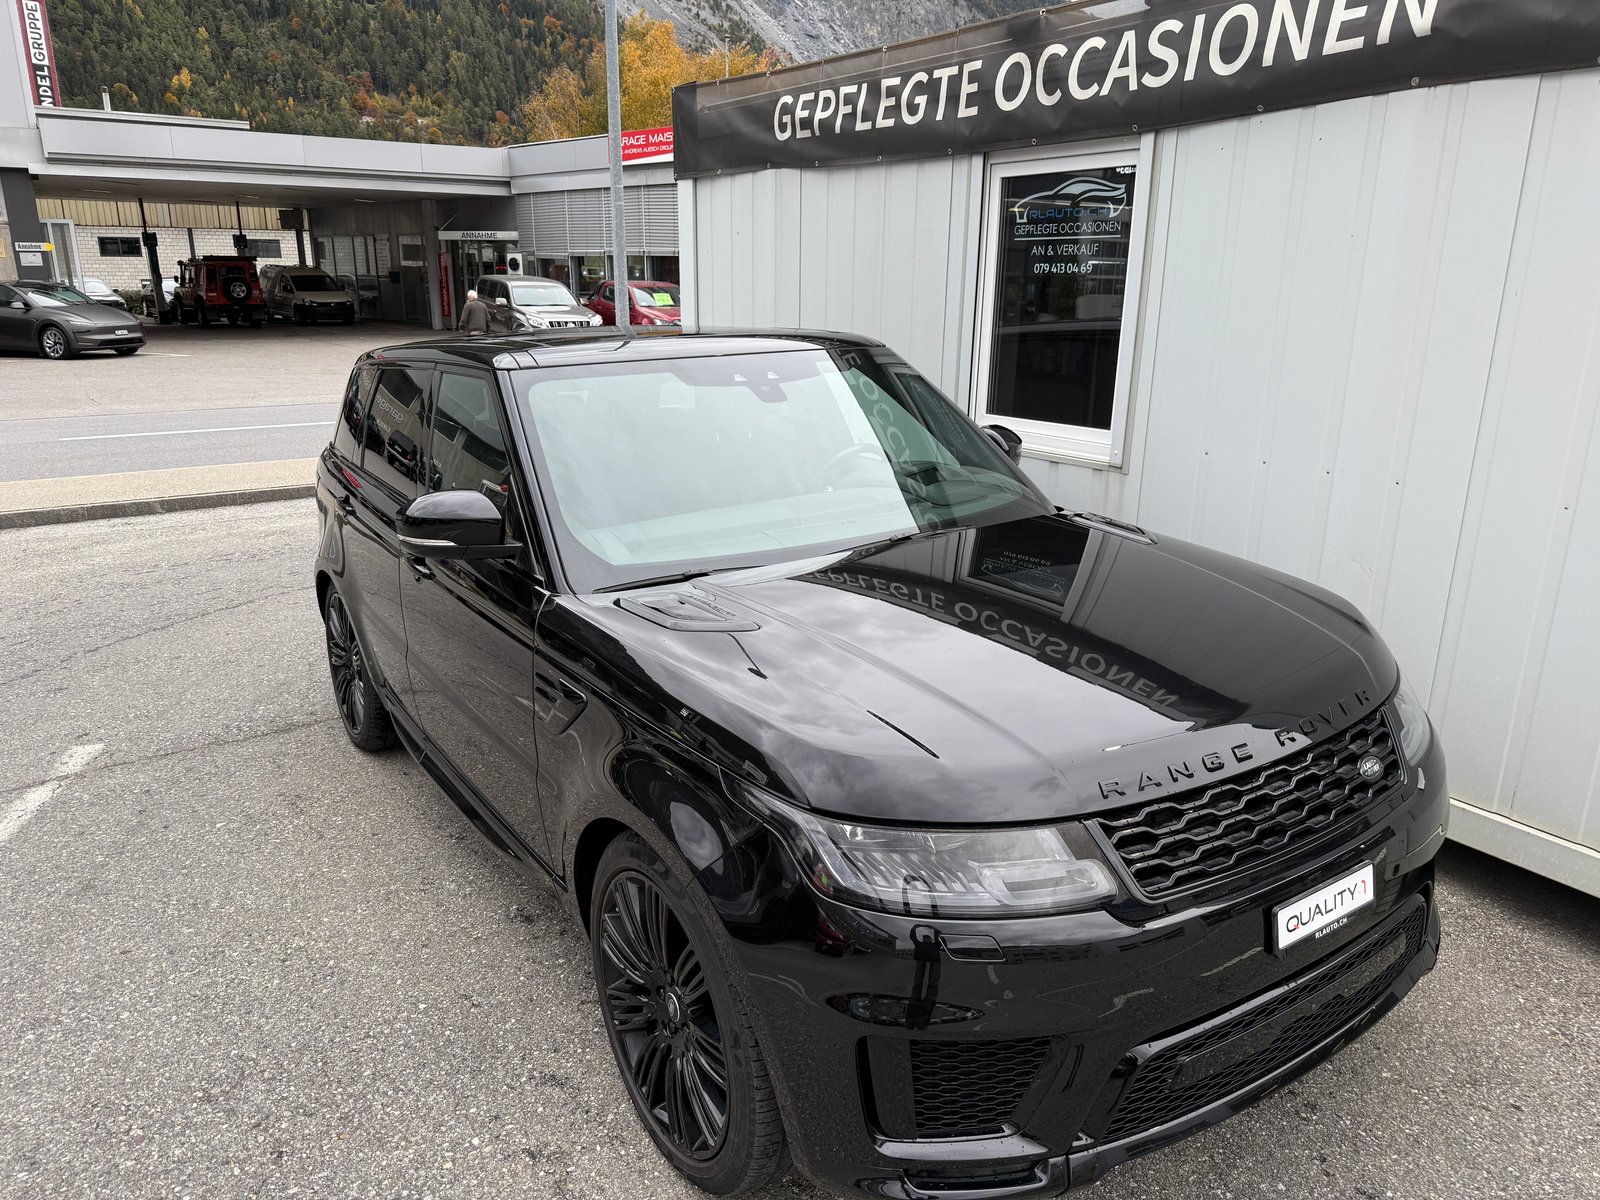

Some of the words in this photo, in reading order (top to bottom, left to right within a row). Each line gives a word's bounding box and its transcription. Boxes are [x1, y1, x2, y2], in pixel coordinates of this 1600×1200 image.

[25, 2, 46, 62] GRUPPE
[773, 60, 983, 142] GEPFLEGTE
[994, 0, 1438, 112] OCCASIONEN
[620, 135, 646, 146] RAGE
[1014, 224, 1058, 236] GEPFLEGTE
[1059, 221, 1122, 234] OCCASIONEN
[1030, 245, 1046, 256] AN
[1047, 246, 1054, 255] &
[1056, 243, 1100, 256] VERKAUF
[1034, 263, 1050, 274] 079
[1051, 263, 1065, 274] 413
[1066, 263, 1079, 273] 04
[1080, 263, 1093, 273] 69
[1098, 742, 1254, 799] RANGE
[1274, 688, 1370, 747] ROVER
[1315, 917, 1348, 939] RLAUTO.CH
